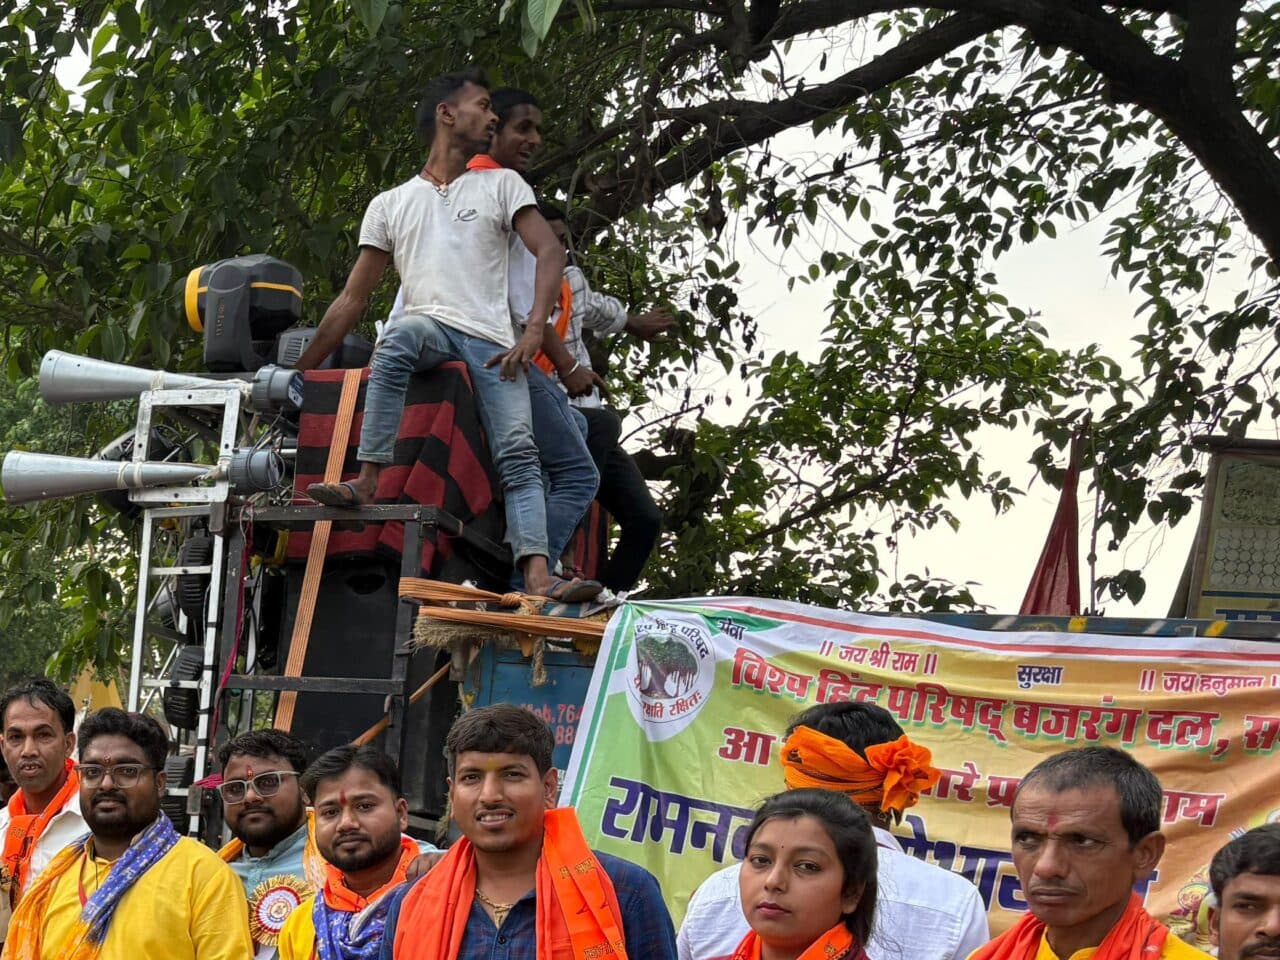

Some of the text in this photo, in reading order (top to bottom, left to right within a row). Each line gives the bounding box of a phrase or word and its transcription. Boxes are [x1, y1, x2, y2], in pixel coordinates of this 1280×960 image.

[839, 645, 868, 664] जय
[869, 641, 890, 669] श्री
[892, 651, 919, 673] राम
[1017, 665, 1063, 688] सुरक्षा
[1163, 672, 1197, 692] जय
[732, 648, 812, 697] विश्व
[888, 683, 1007, 741] परिषद्
[1014, 696, 1143, 743] बजरंग
[1163, 790, 1225, 826] ाम
